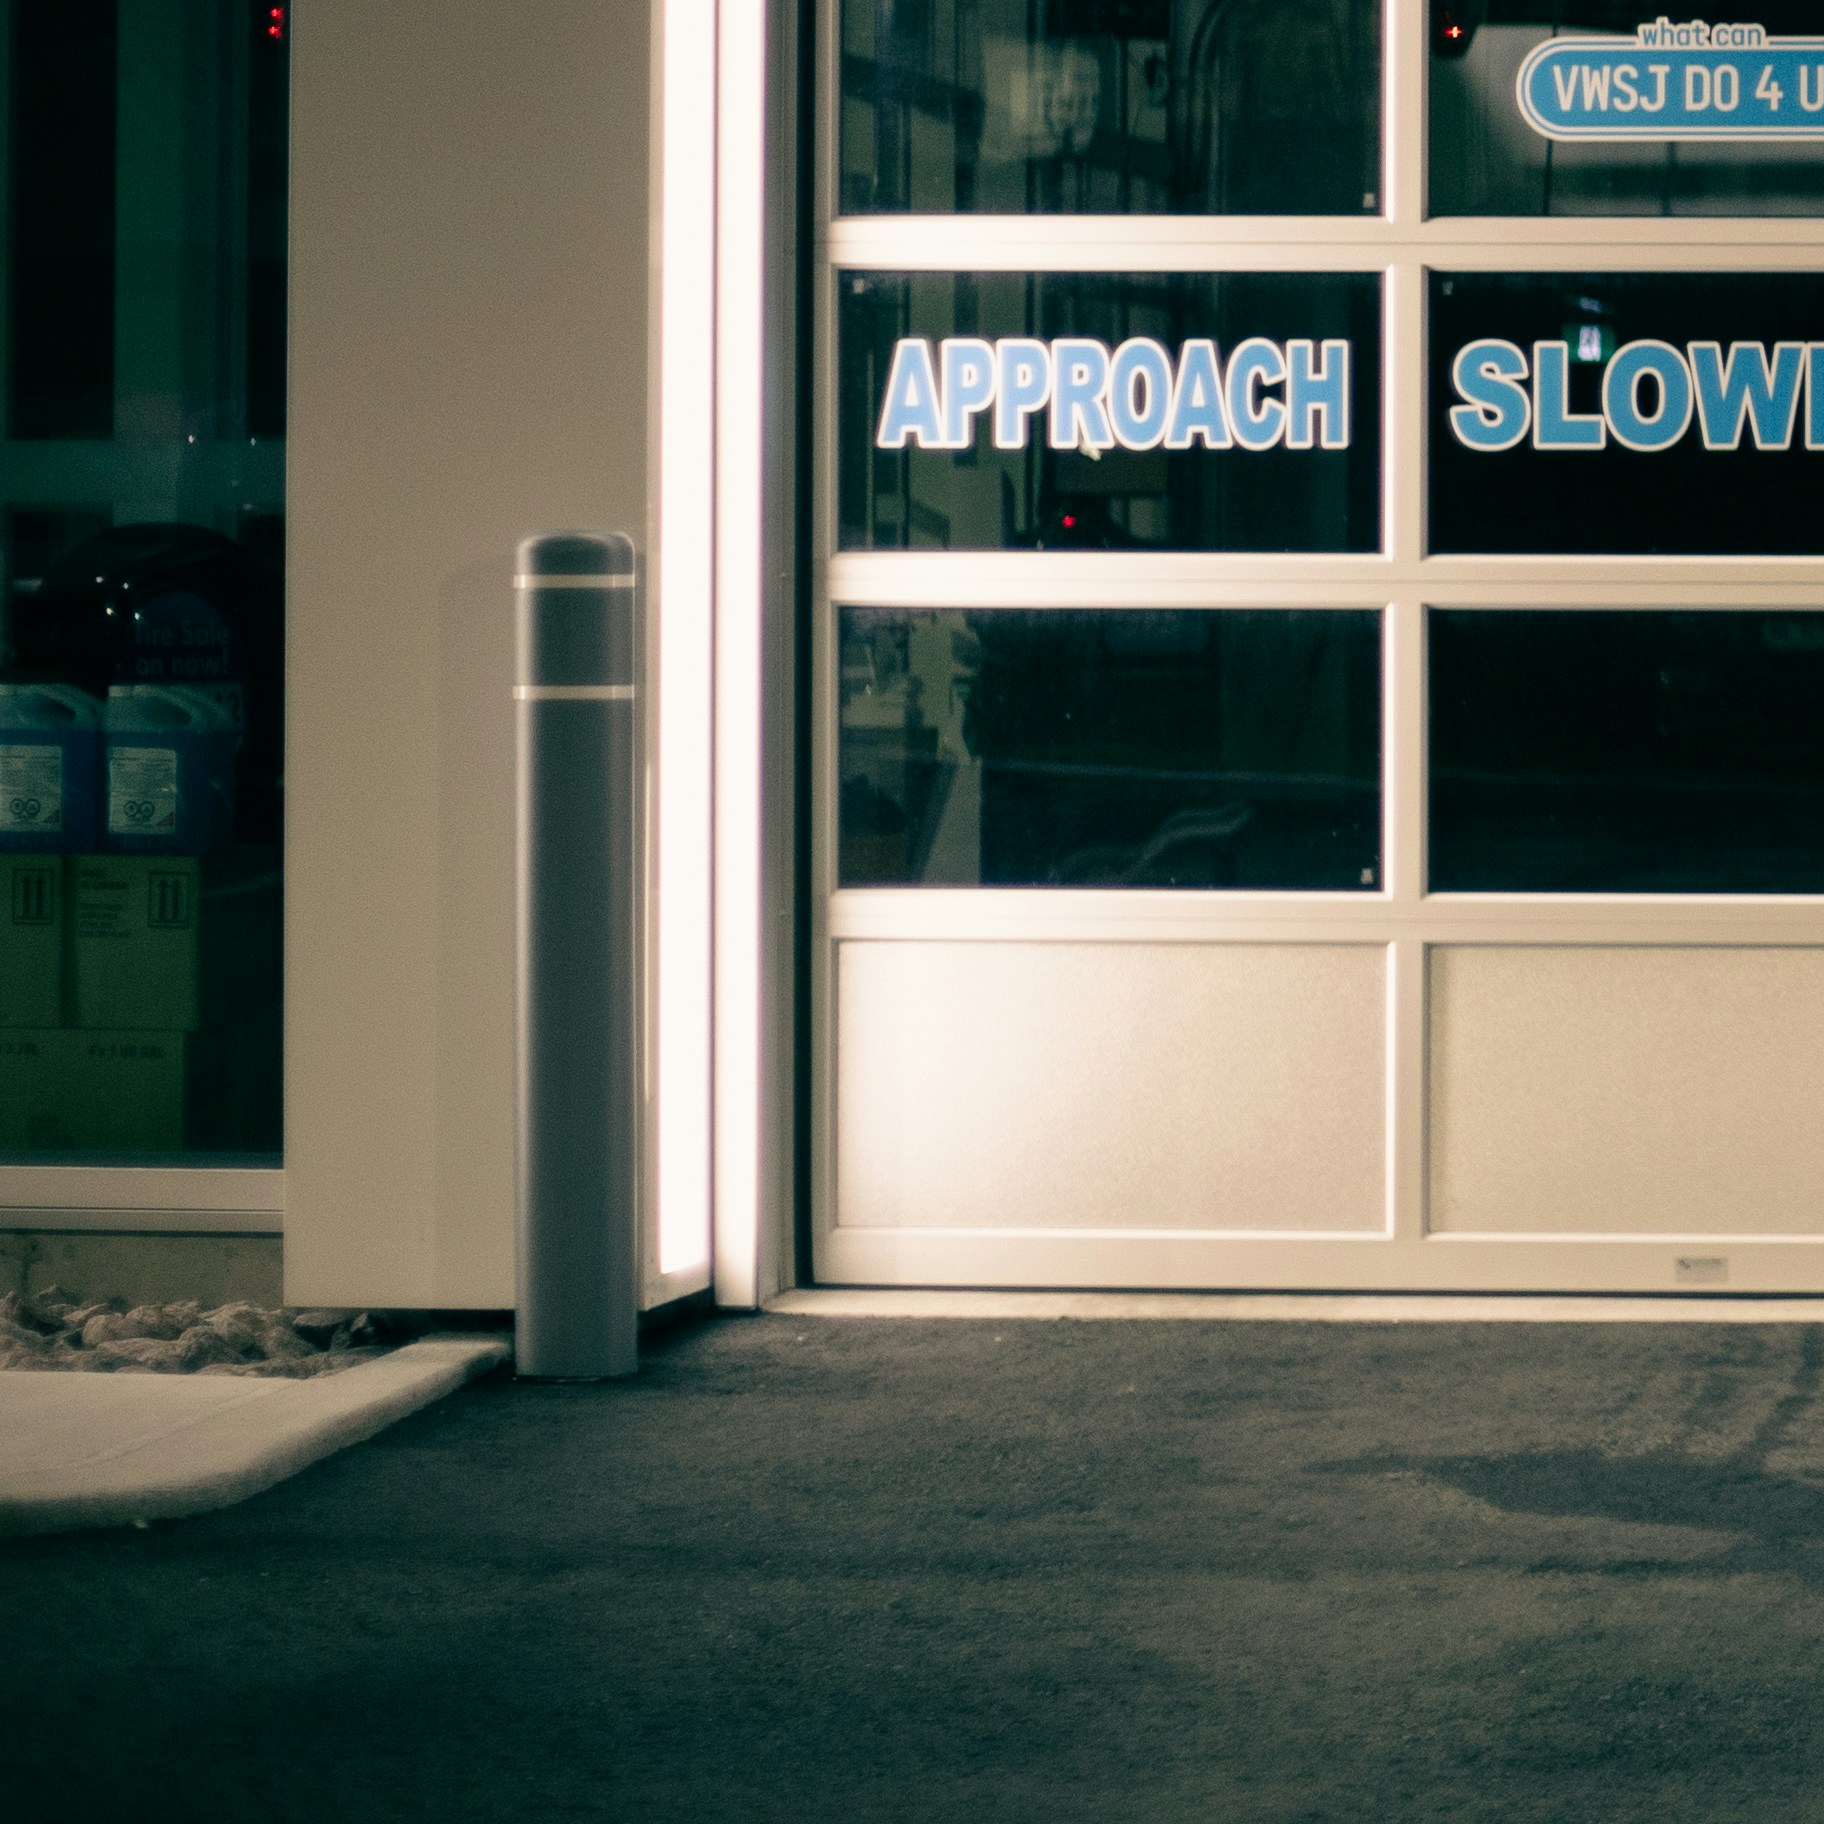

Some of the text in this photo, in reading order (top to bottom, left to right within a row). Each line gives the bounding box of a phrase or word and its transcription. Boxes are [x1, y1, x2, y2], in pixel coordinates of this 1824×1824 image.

[1641, 21, 1763, 47] what can
[1552, 64, 1672, 112] VWSJ
[1685, 64, 1740, 112] DO
[1755, 64, 1784, 112] 4
[875, 337, 1351, 452] APPROACH
[181, 616, 230, 646] Sale
[135, 656, 164, 675] on
